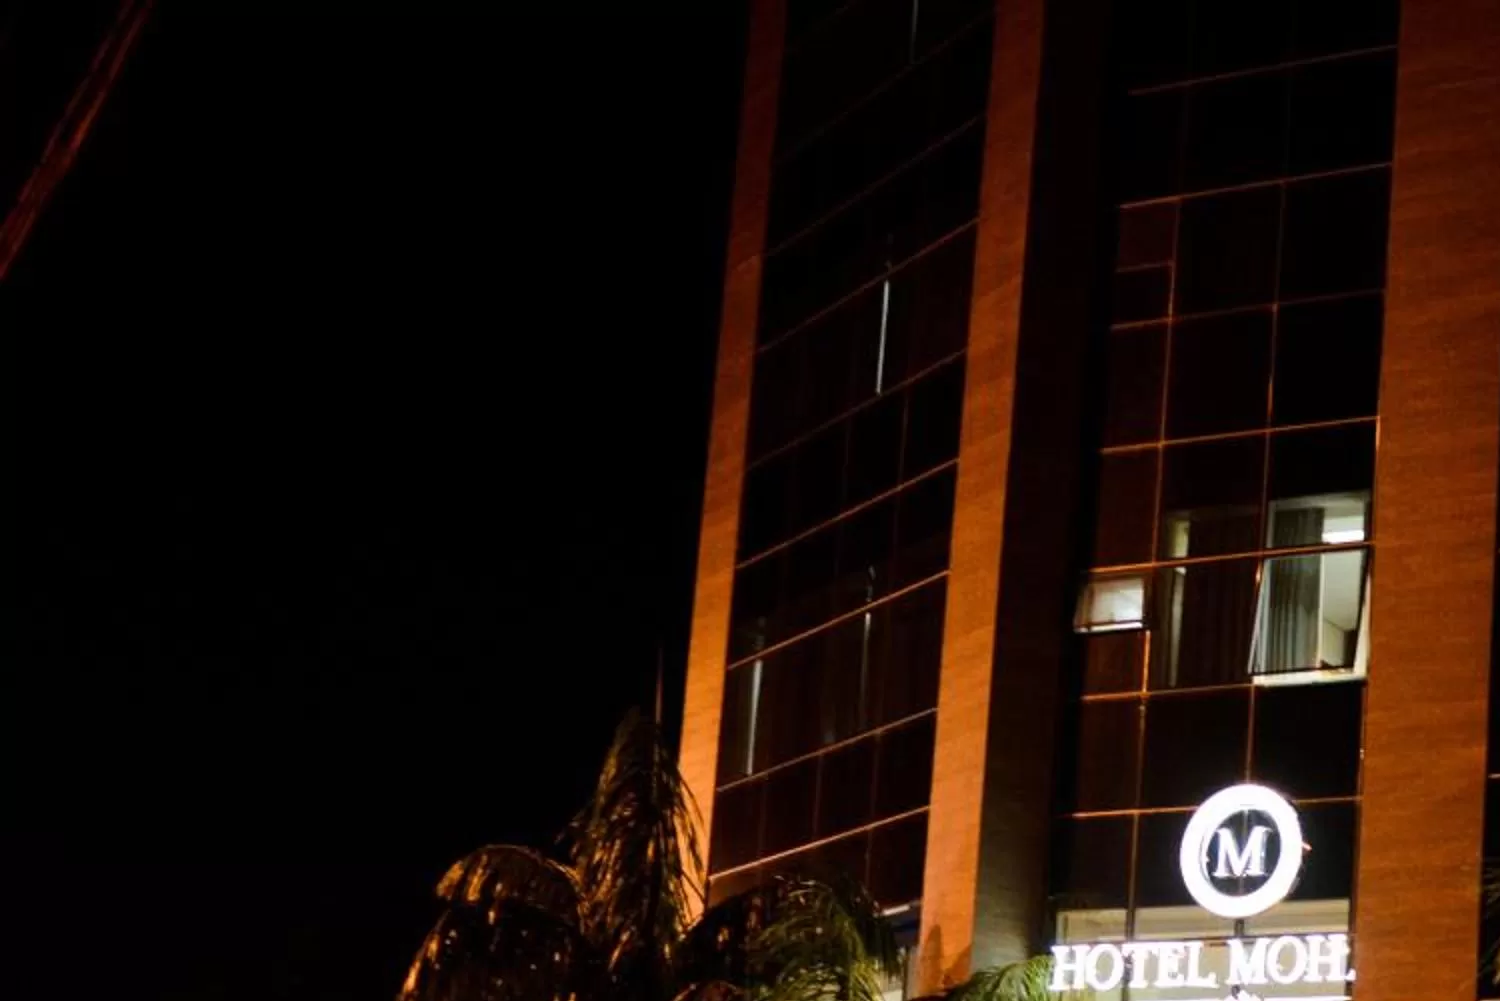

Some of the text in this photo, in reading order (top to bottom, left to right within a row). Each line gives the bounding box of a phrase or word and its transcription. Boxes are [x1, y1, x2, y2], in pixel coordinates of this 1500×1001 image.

[1212, 826, 1273, 878] M
[1051, 933, 1356, 990] HOTEL MOH
